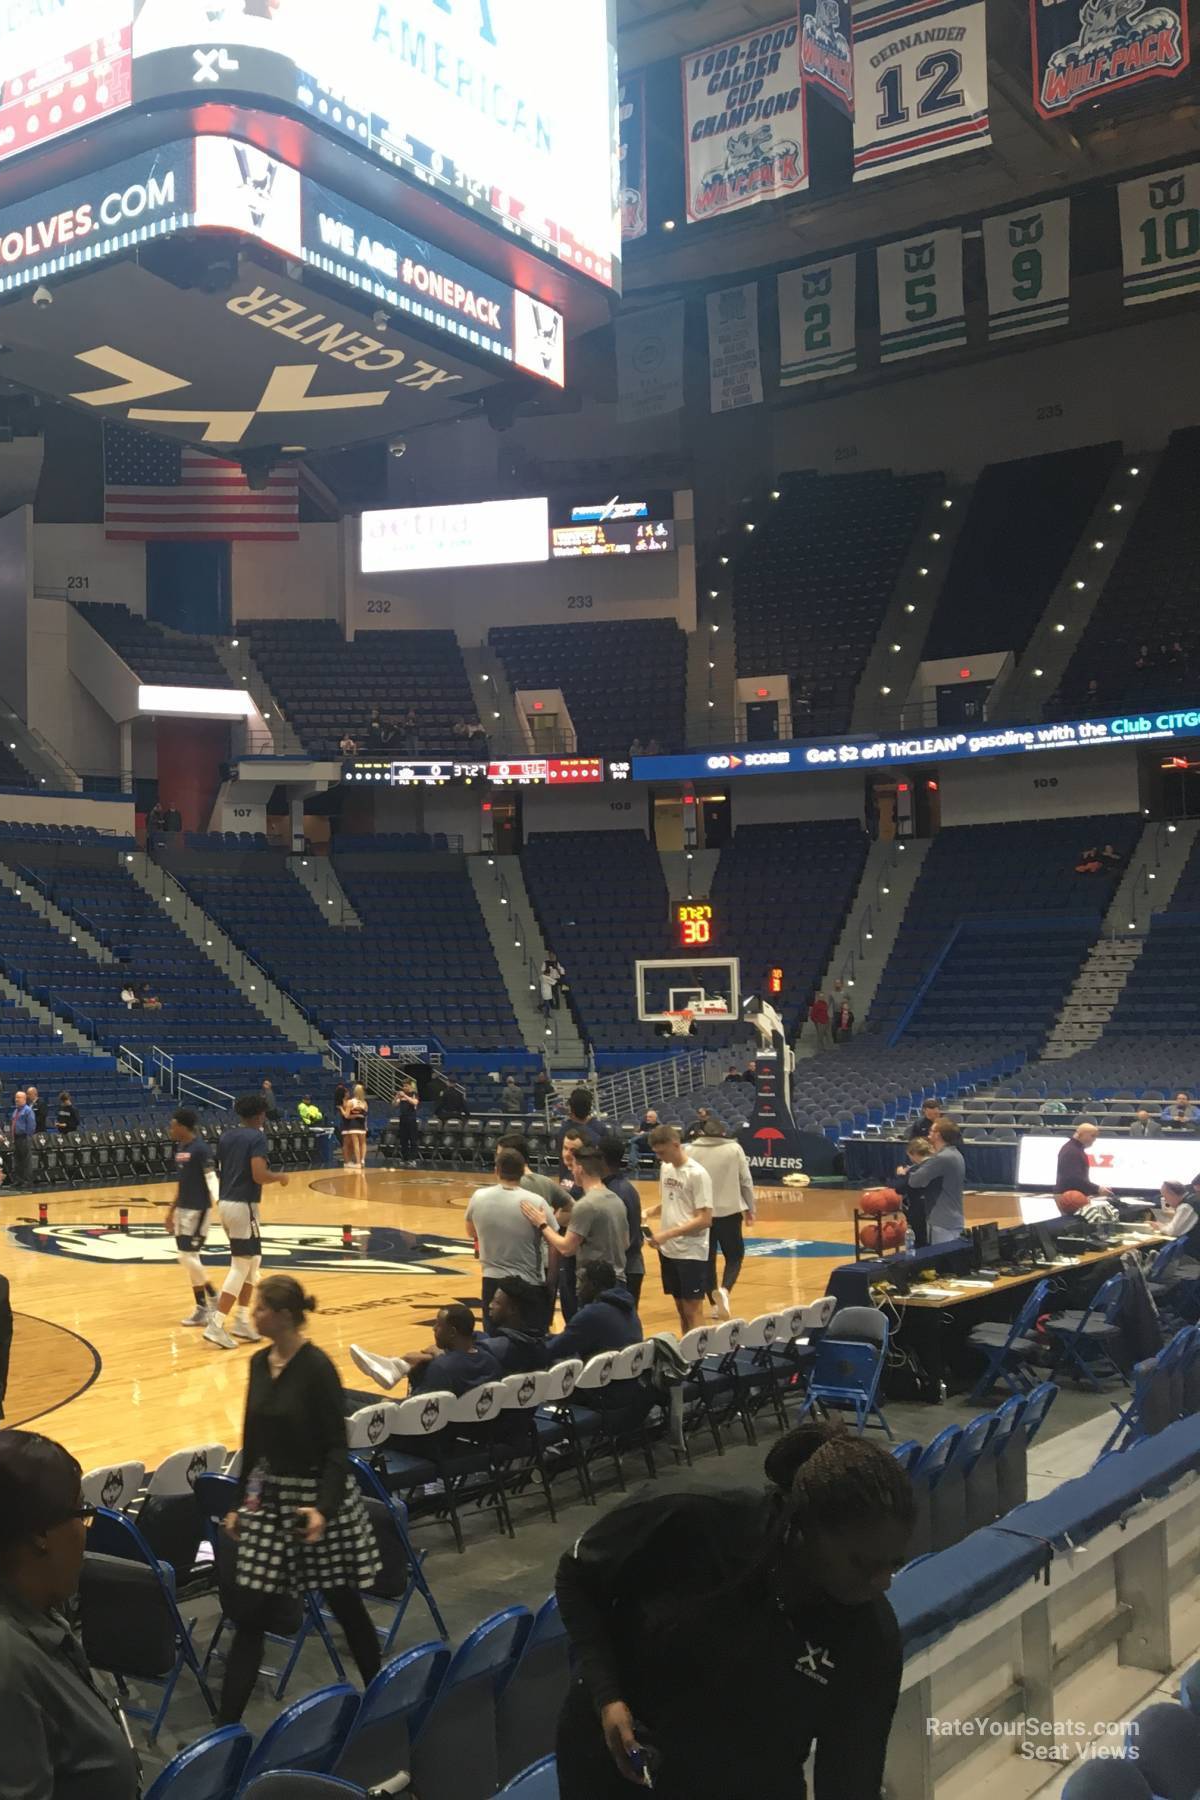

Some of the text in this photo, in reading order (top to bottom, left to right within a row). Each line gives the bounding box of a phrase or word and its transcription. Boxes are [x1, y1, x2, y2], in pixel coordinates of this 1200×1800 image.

[871, 26, 966, 68] GERNANDER
[192, 49, 238, 82] XL
[707, 52, 781, 96] CALDER
[726, 79, 764, 110] CUP
[876, 49, 965, 130] 12
[691, 87, 801, 142] CHAMPIONS
[318, 212, 355, 256] WE
[402, 257, 503, 329] #ONEPACK
[1012, 248, 1043, 300] 9
[905, 273, 937, 322] 5
[226, 286, 405, 371] CENTER
[805, 303, 831, 352] 2
[1037, 404, 1063, 420] 235
[67, 576, 89, 589] 231
[367, 600, 391, 613] 232
[567, 596, 593, 609] 233
[707, 756, 730, 770] GO
[806, 748, 837, 763] Get
[839, 745, 860, 763] $2
[862, 744, 886, 759] off
[969, 730, 1035, 752] gasoline
[1038, 725, 1075, 742] with
[1079, 722, 1108, 737] the
[1111, 717, 1152, 734] Club
[454, 764, 487, 776] 37:27
[1033, 777, 1058, 788] 109
[232, 807, 252, 818] 107
[679, 906, 712, 920] 37:27
[684, 920, 710, 943] 30
[746, 1157, 803, 1169] RAVELERS
